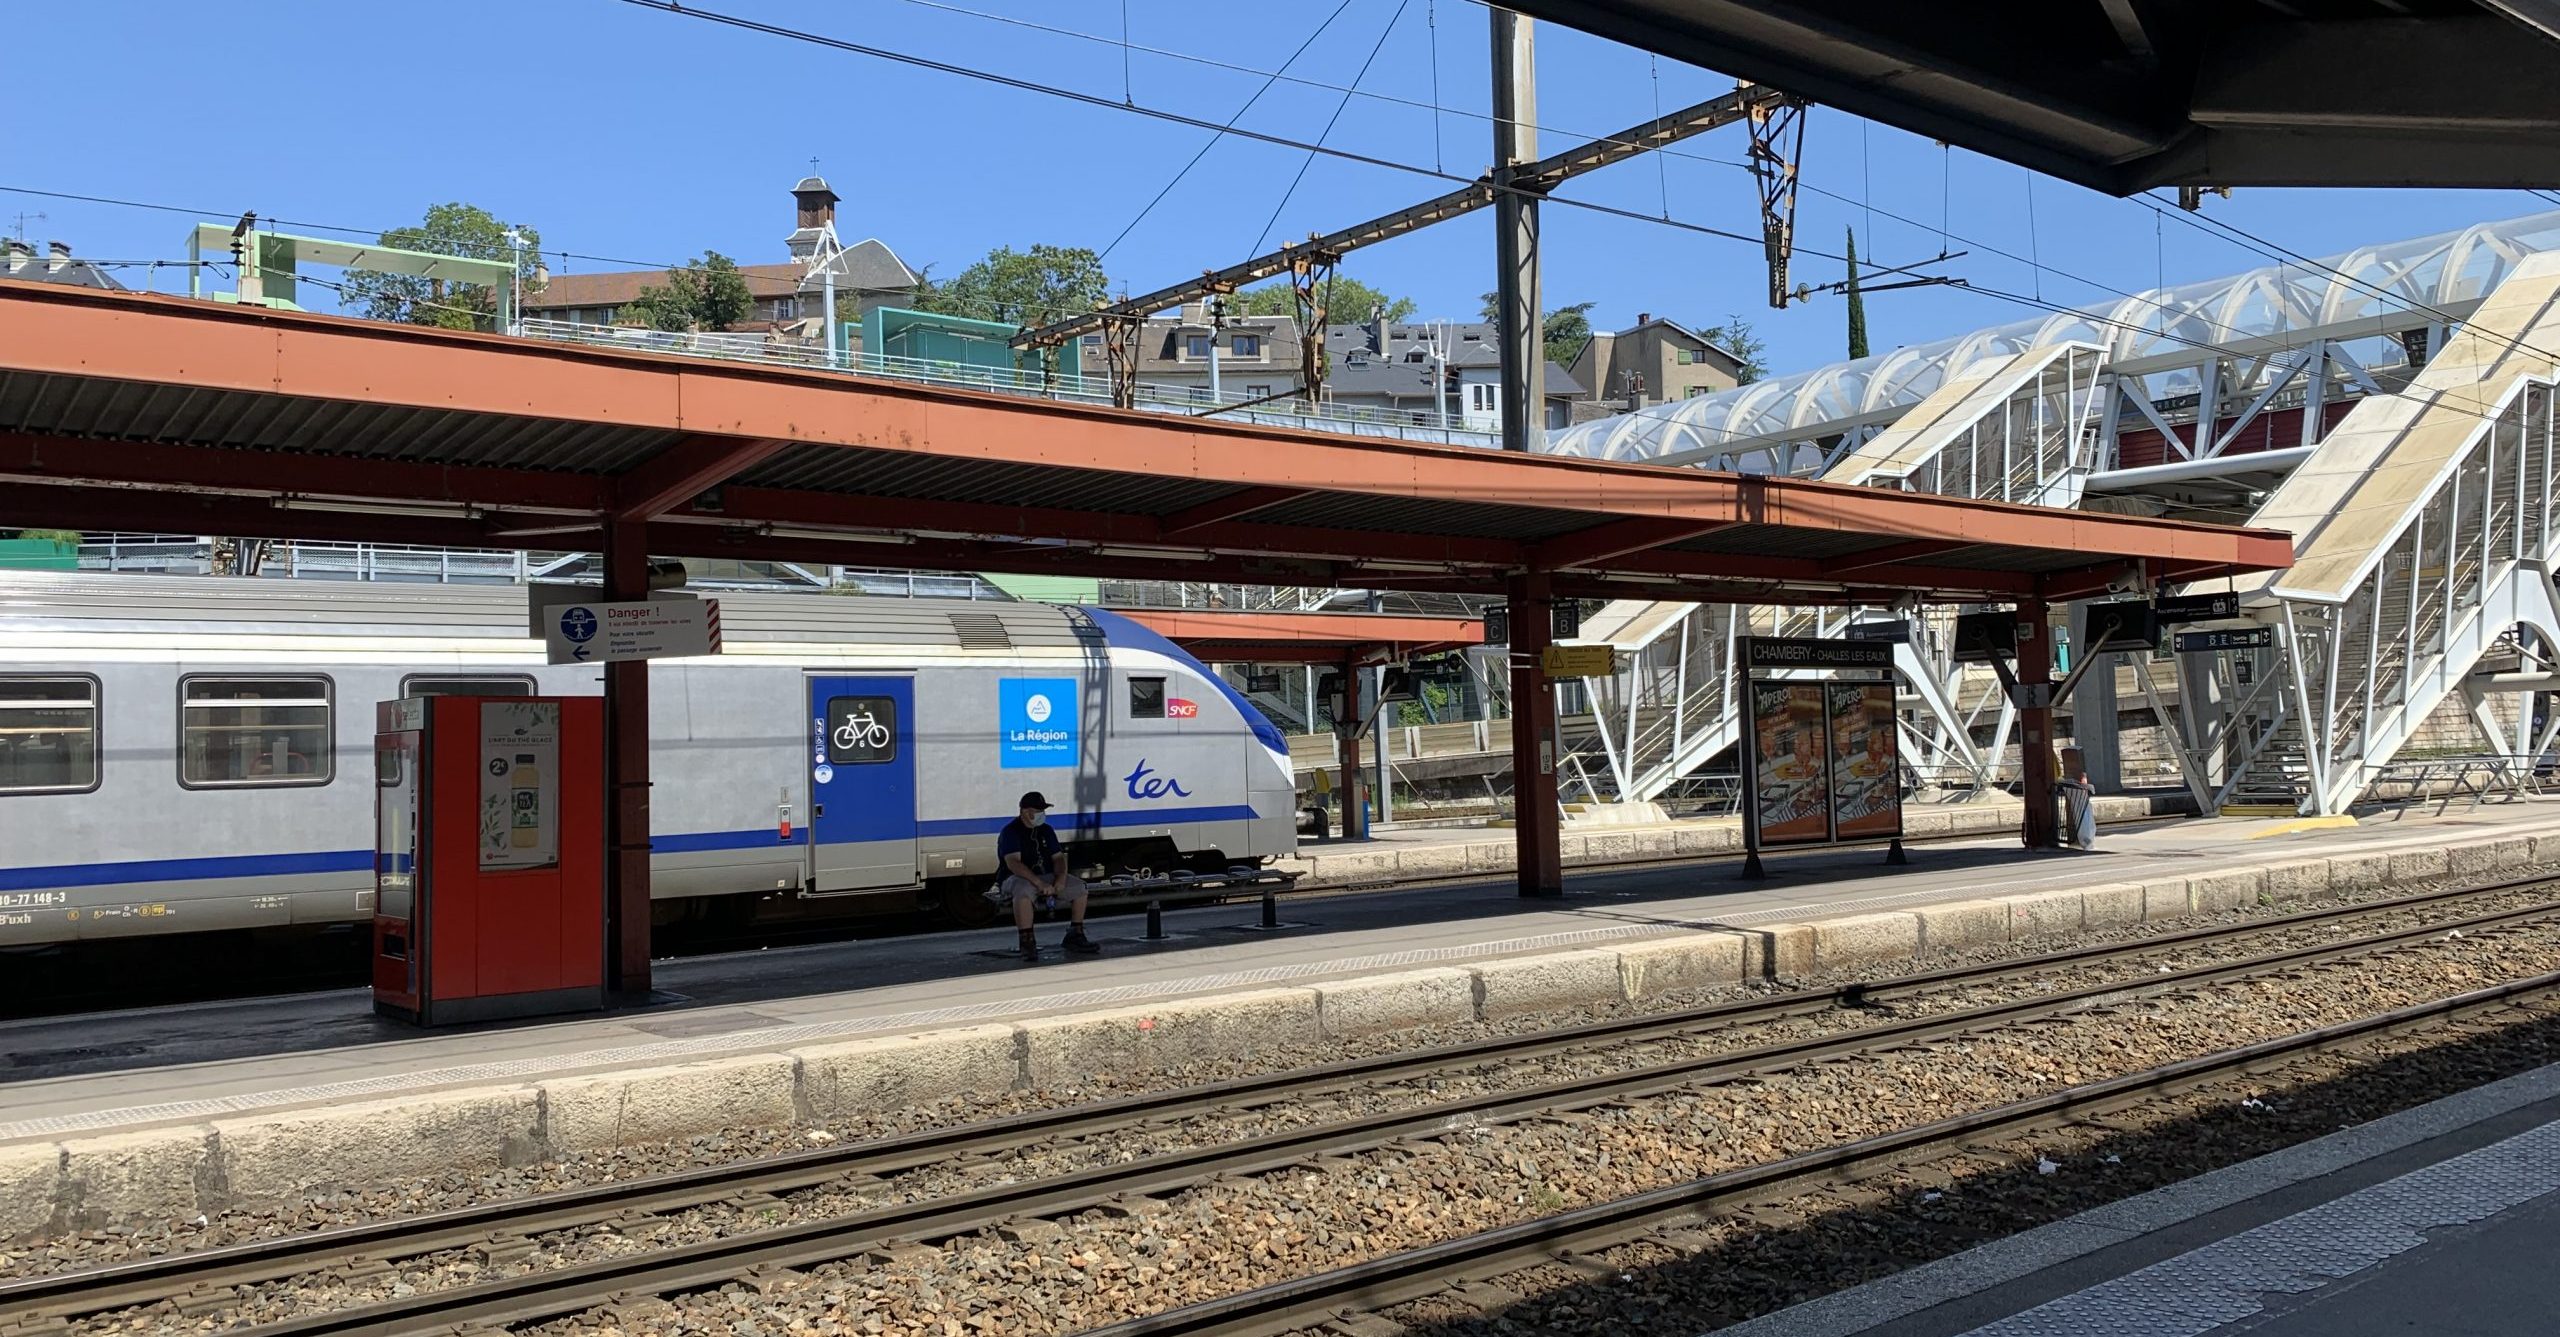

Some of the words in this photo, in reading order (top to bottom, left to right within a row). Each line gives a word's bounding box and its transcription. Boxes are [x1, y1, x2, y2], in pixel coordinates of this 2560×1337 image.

[608, 607, 651, 619] Danger
[656, 607, 660, 616] !
[1490, 625, 1498, 639] C
[1560, 619, 1569, 633] B
[1754, 644, 1812, 660] CHAMBERY
[1817, 651, 1849, 661] CHALLES
[1851, 650, 1864, 661] LES
[1866, 650, 1887, 662] EAUX
[1759, 686, 1793, 709] APEROL
[1834, 687, 1866, 710] APEROL
[1168, 705, 1197, 716] SNCF
[1010, 729, 1025, 741] La
[1027, 729, 1068, 743] Région
[859, 740, 865, 748] 6
[1123, 758, 1192, 799] ter
